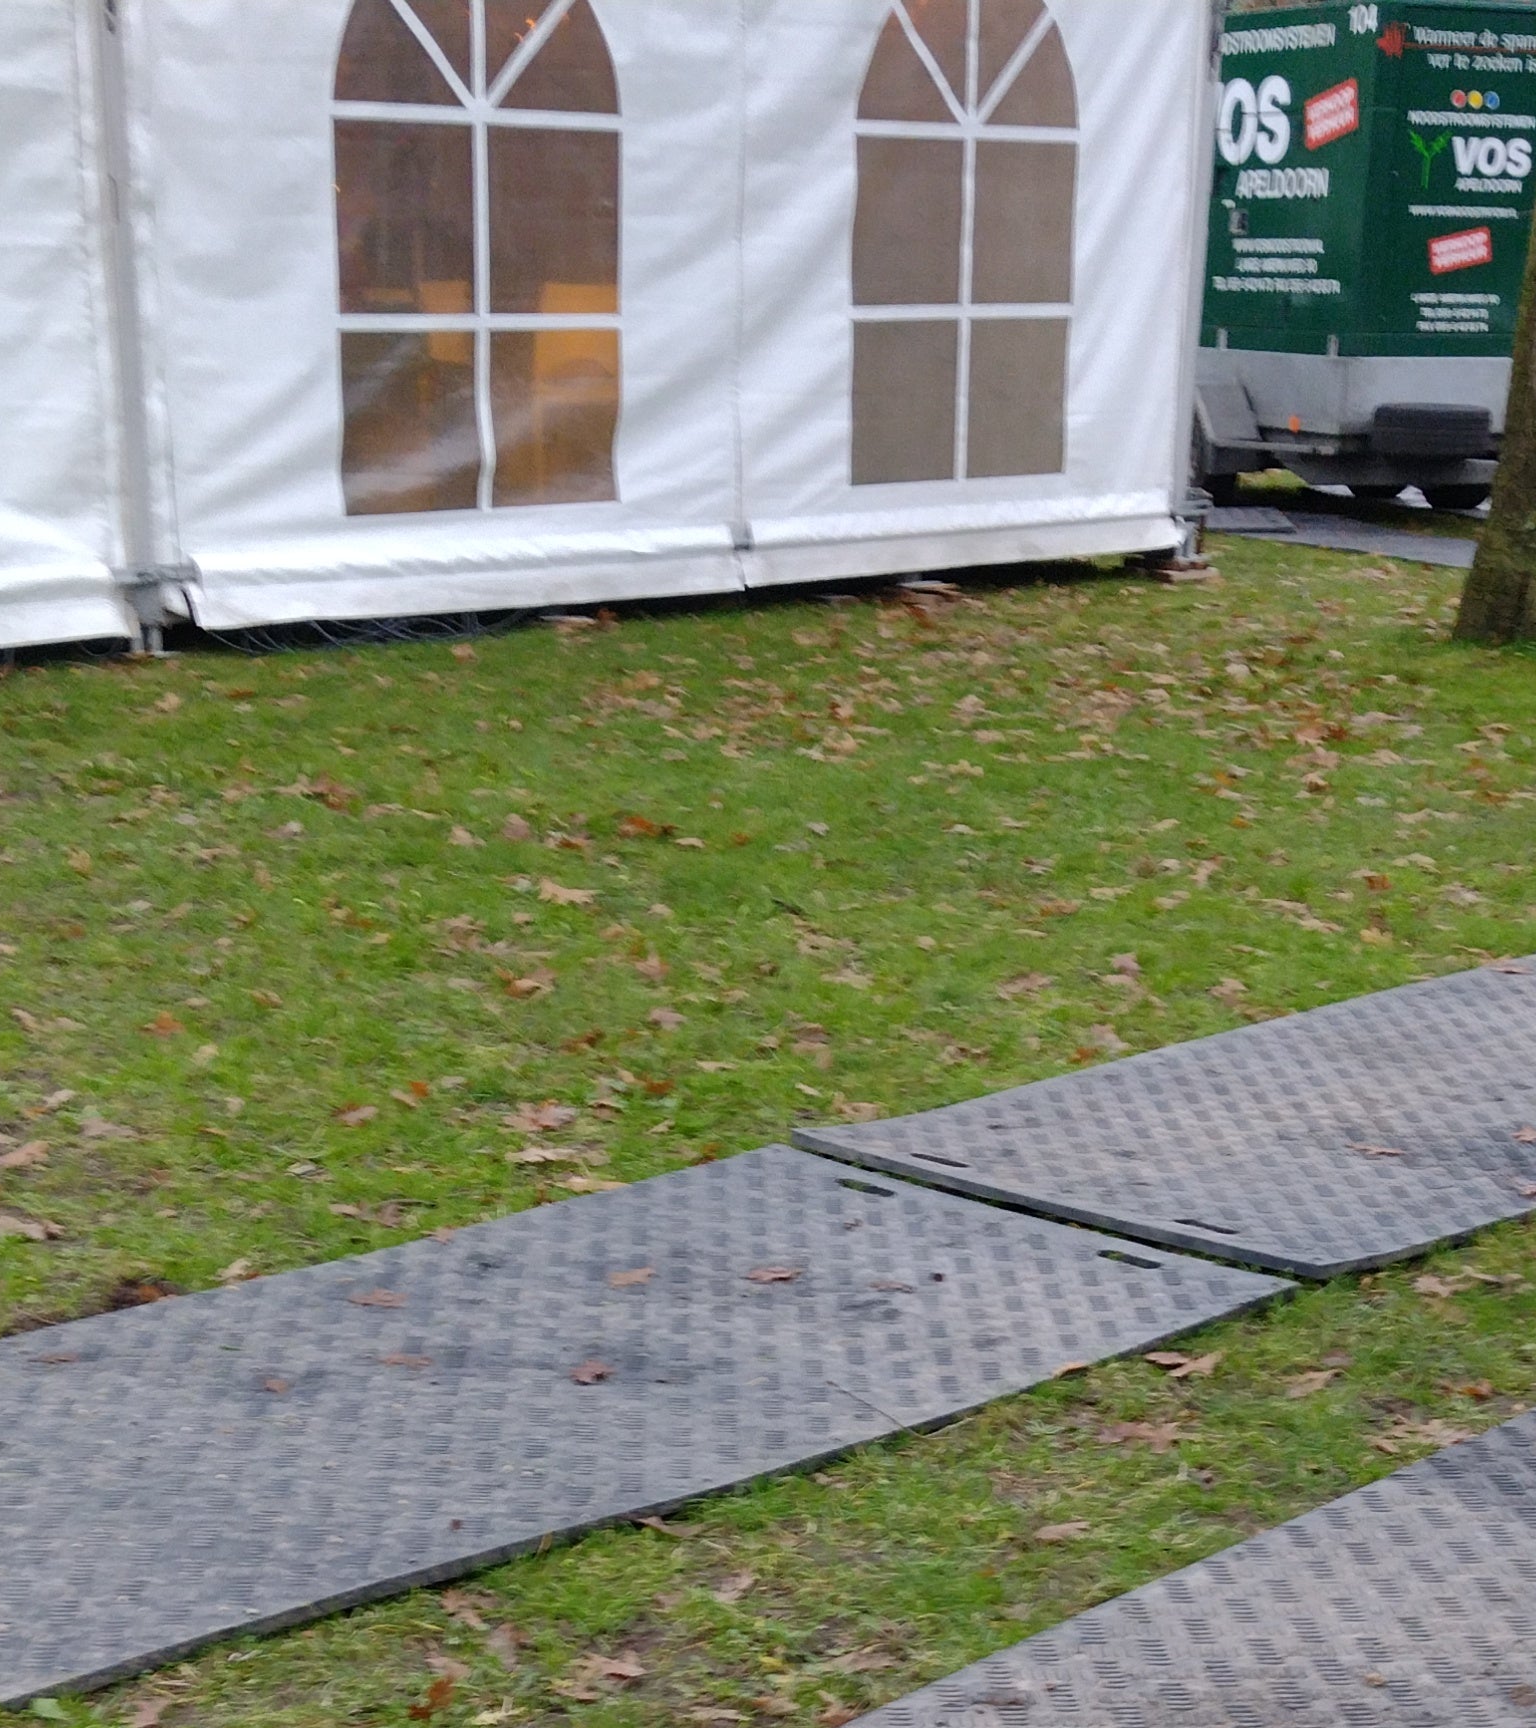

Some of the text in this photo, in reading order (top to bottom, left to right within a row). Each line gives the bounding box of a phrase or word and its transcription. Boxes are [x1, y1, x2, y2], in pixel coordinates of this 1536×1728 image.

[1216, 75, 1292, 166] OS
[1451, 136, 1533, 178] VOS
[1235, 167, 1330, 199] APELDOORN
